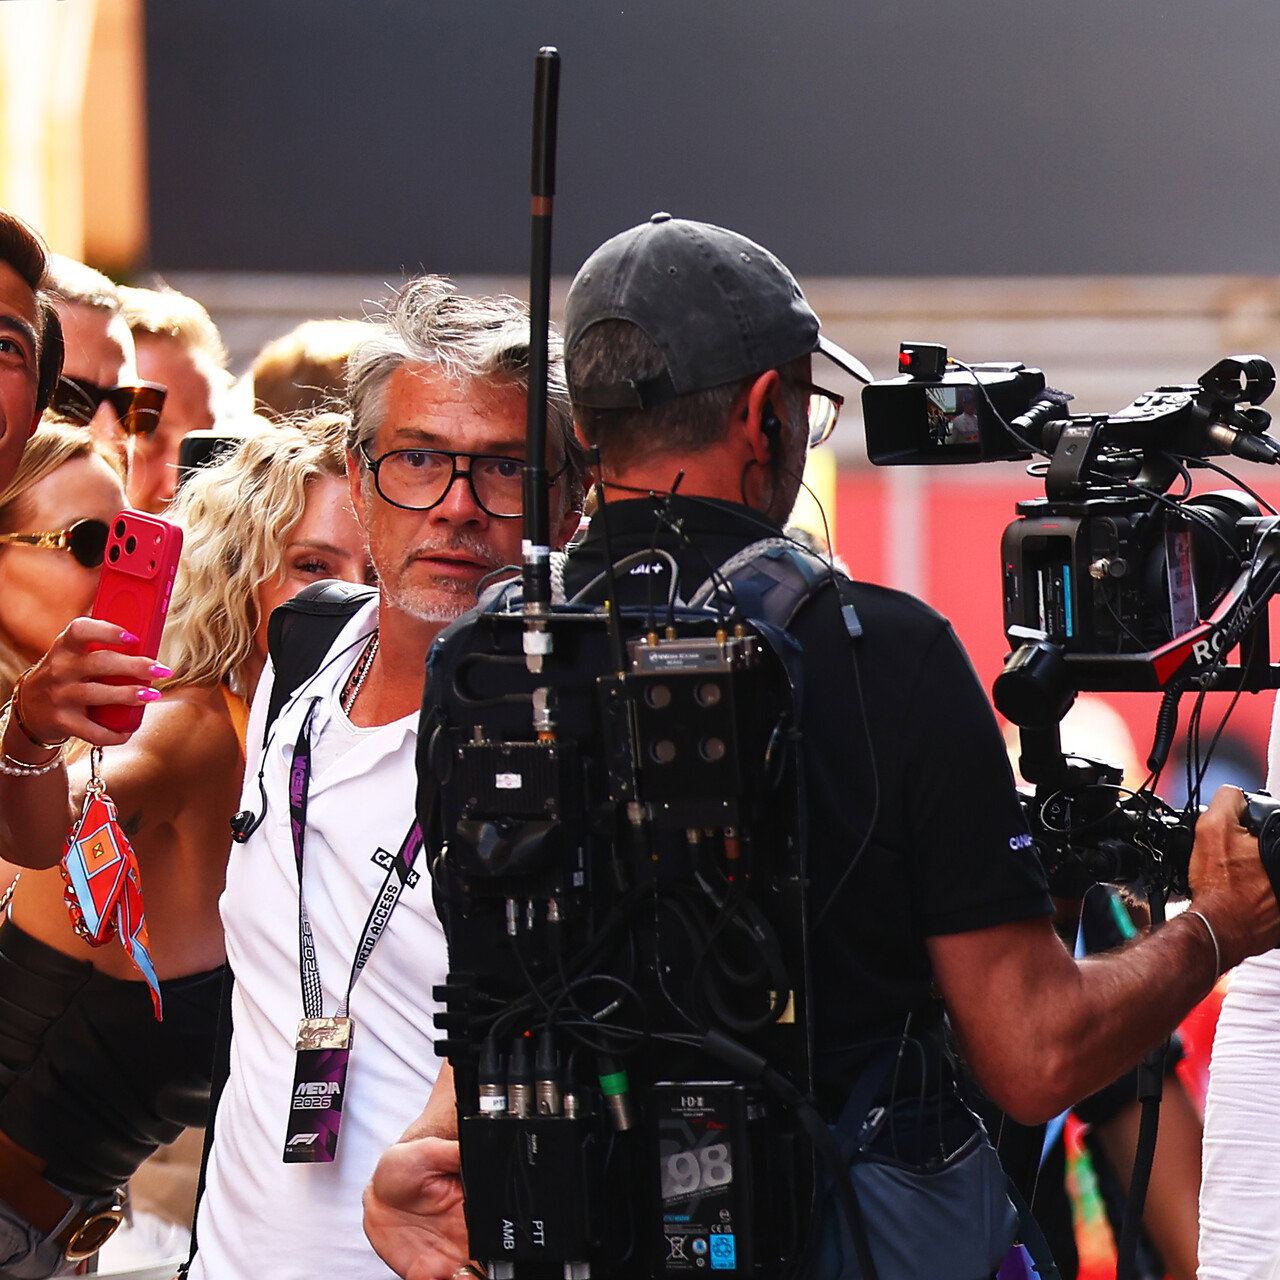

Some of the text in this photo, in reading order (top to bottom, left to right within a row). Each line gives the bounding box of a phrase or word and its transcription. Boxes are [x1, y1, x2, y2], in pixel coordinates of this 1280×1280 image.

[356, 884, 399, 970] GRID ACCESS
[295, 1082, 340, 1095] MEDIA
[293, 1095, 332, 1110] 2026
[287, 1133, 320, 1145] F1
[667, 1144, 733, 1193] 98
[503, 1219, 515, 1250] AMB
[532, 1220, 545, 1246] PTT
